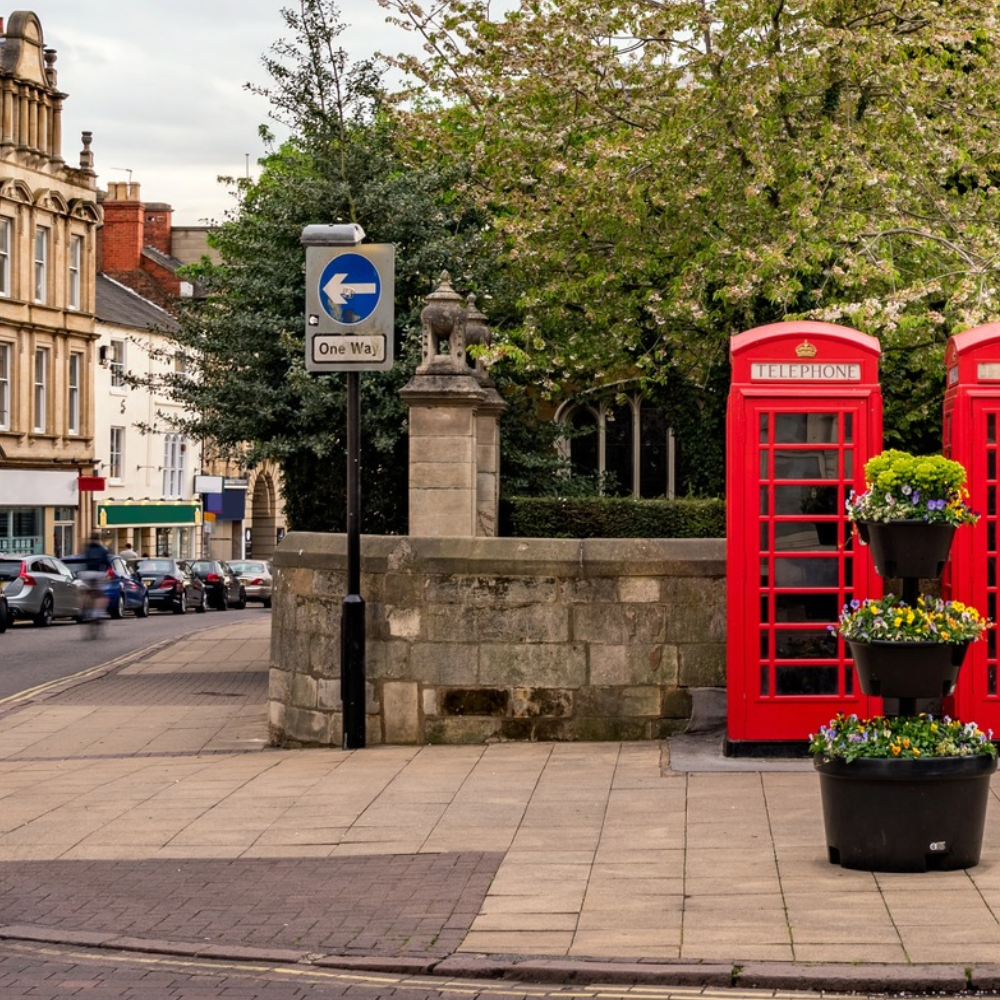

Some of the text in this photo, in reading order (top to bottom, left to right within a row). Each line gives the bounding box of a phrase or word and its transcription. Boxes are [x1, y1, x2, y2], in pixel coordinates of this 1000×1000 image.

[319, 342, 379, 357] One Way
[756, 364, 857, 379] TELEPHONE
